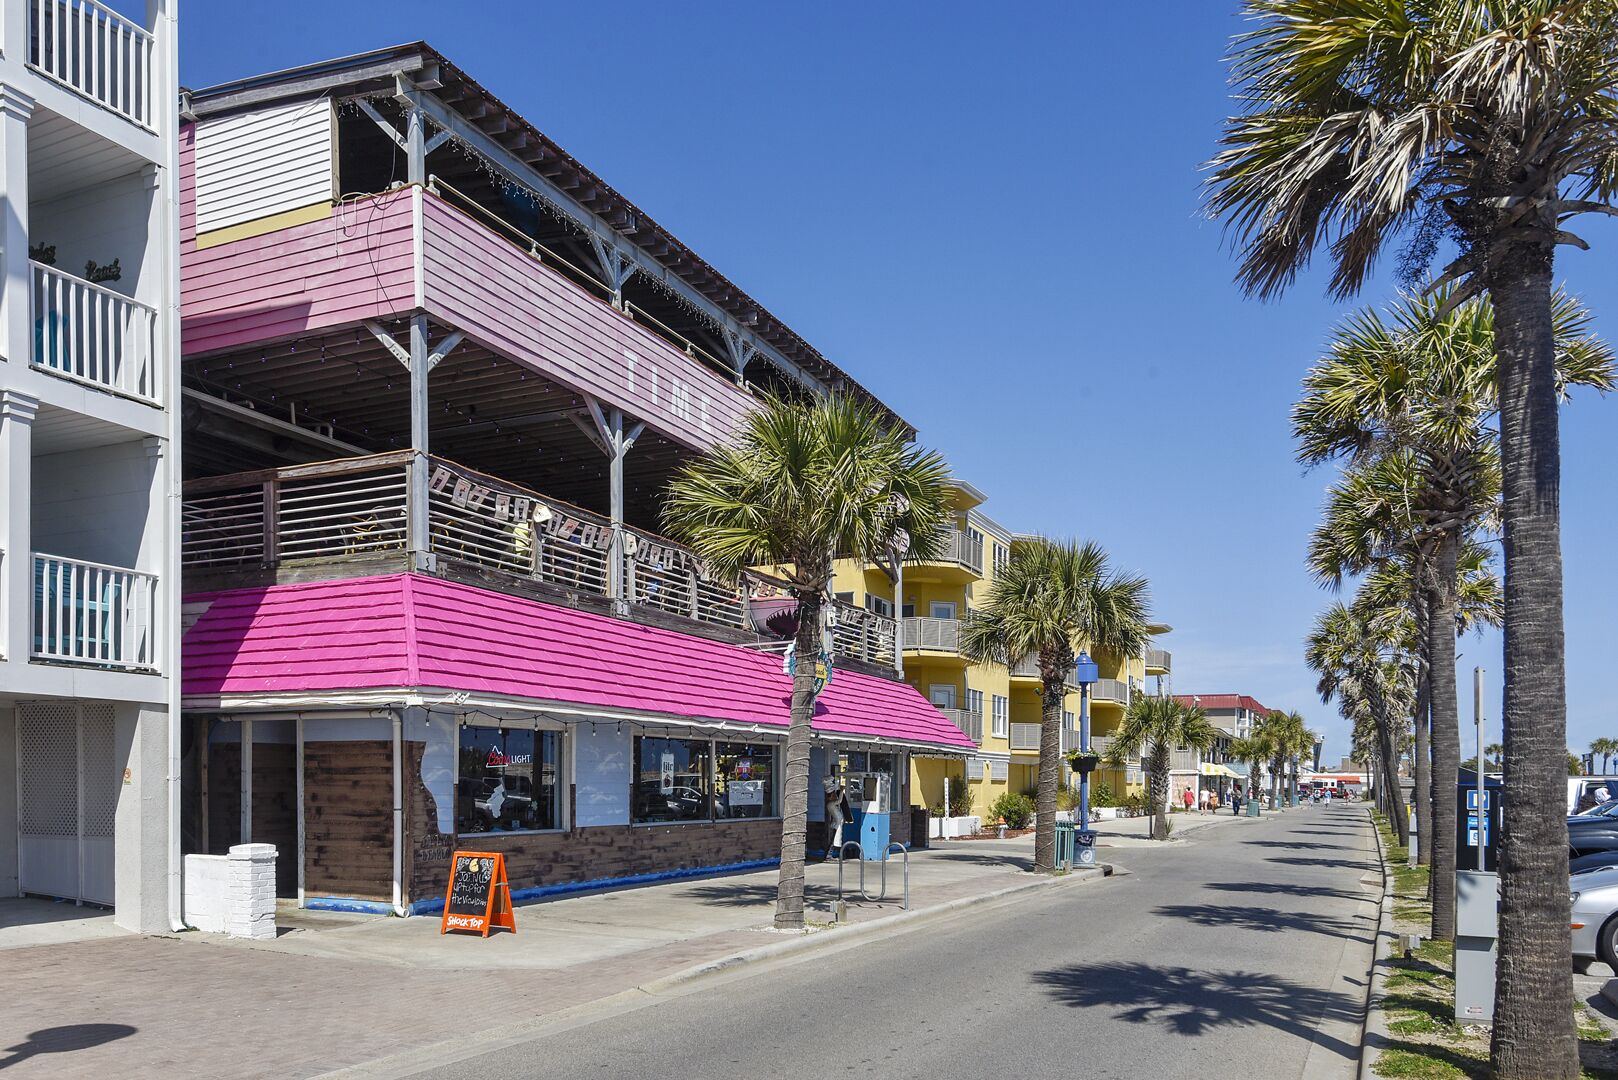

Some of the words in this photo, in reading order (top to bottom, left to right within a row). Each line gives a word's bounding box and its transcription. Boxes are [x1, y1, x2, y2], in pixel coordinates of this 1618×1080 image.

[511, 754, 531, 764] LIGHT
[447, 916, 469, 926] SHOCK
[469, 918, 484, 928] TOP
